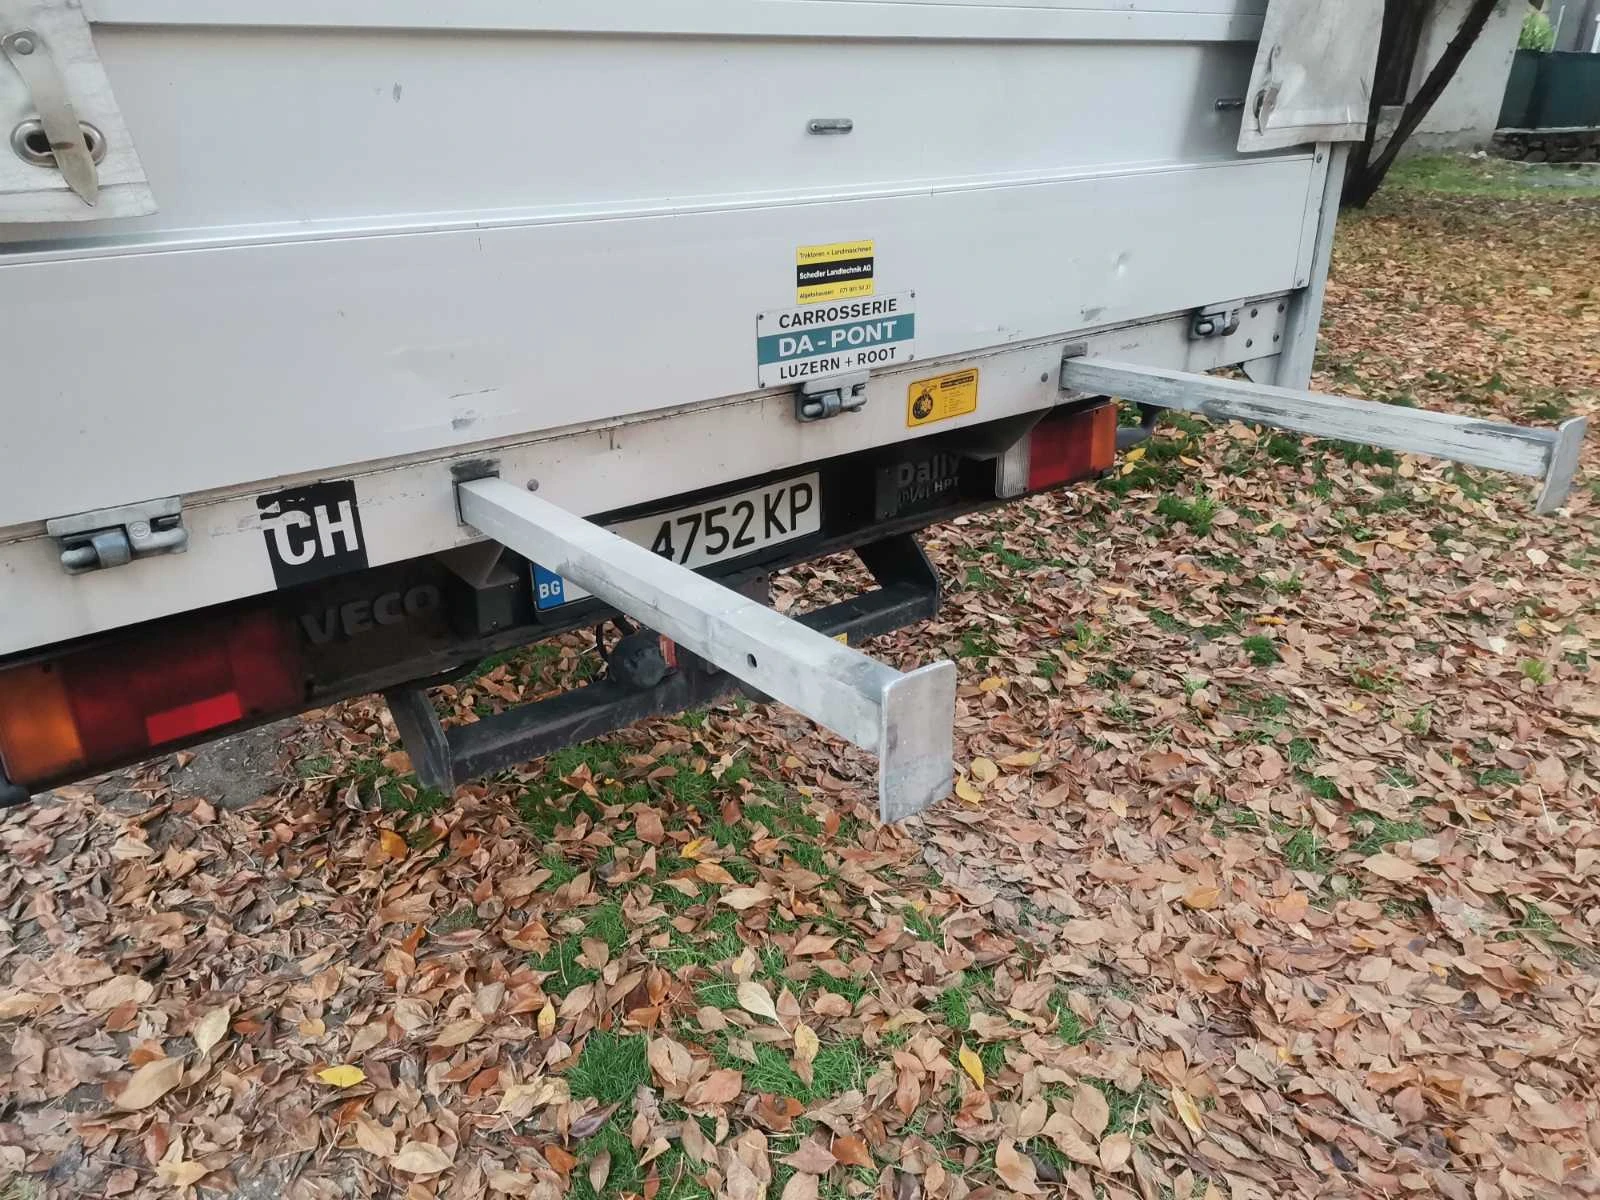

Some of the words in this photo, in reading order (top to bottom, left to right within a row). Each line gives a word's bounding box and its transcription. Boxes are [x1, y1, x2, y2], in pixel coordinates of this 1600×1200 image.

[779, 299, 898, 329] CARROSSERIE
[780, 357, 840, 380] LUZERN
[845, 357, 853, 368] +
[857, 347, 897, 366] ROOT
[273, 500, 359, 566] CH
[539, 580, 561, 600] BG
